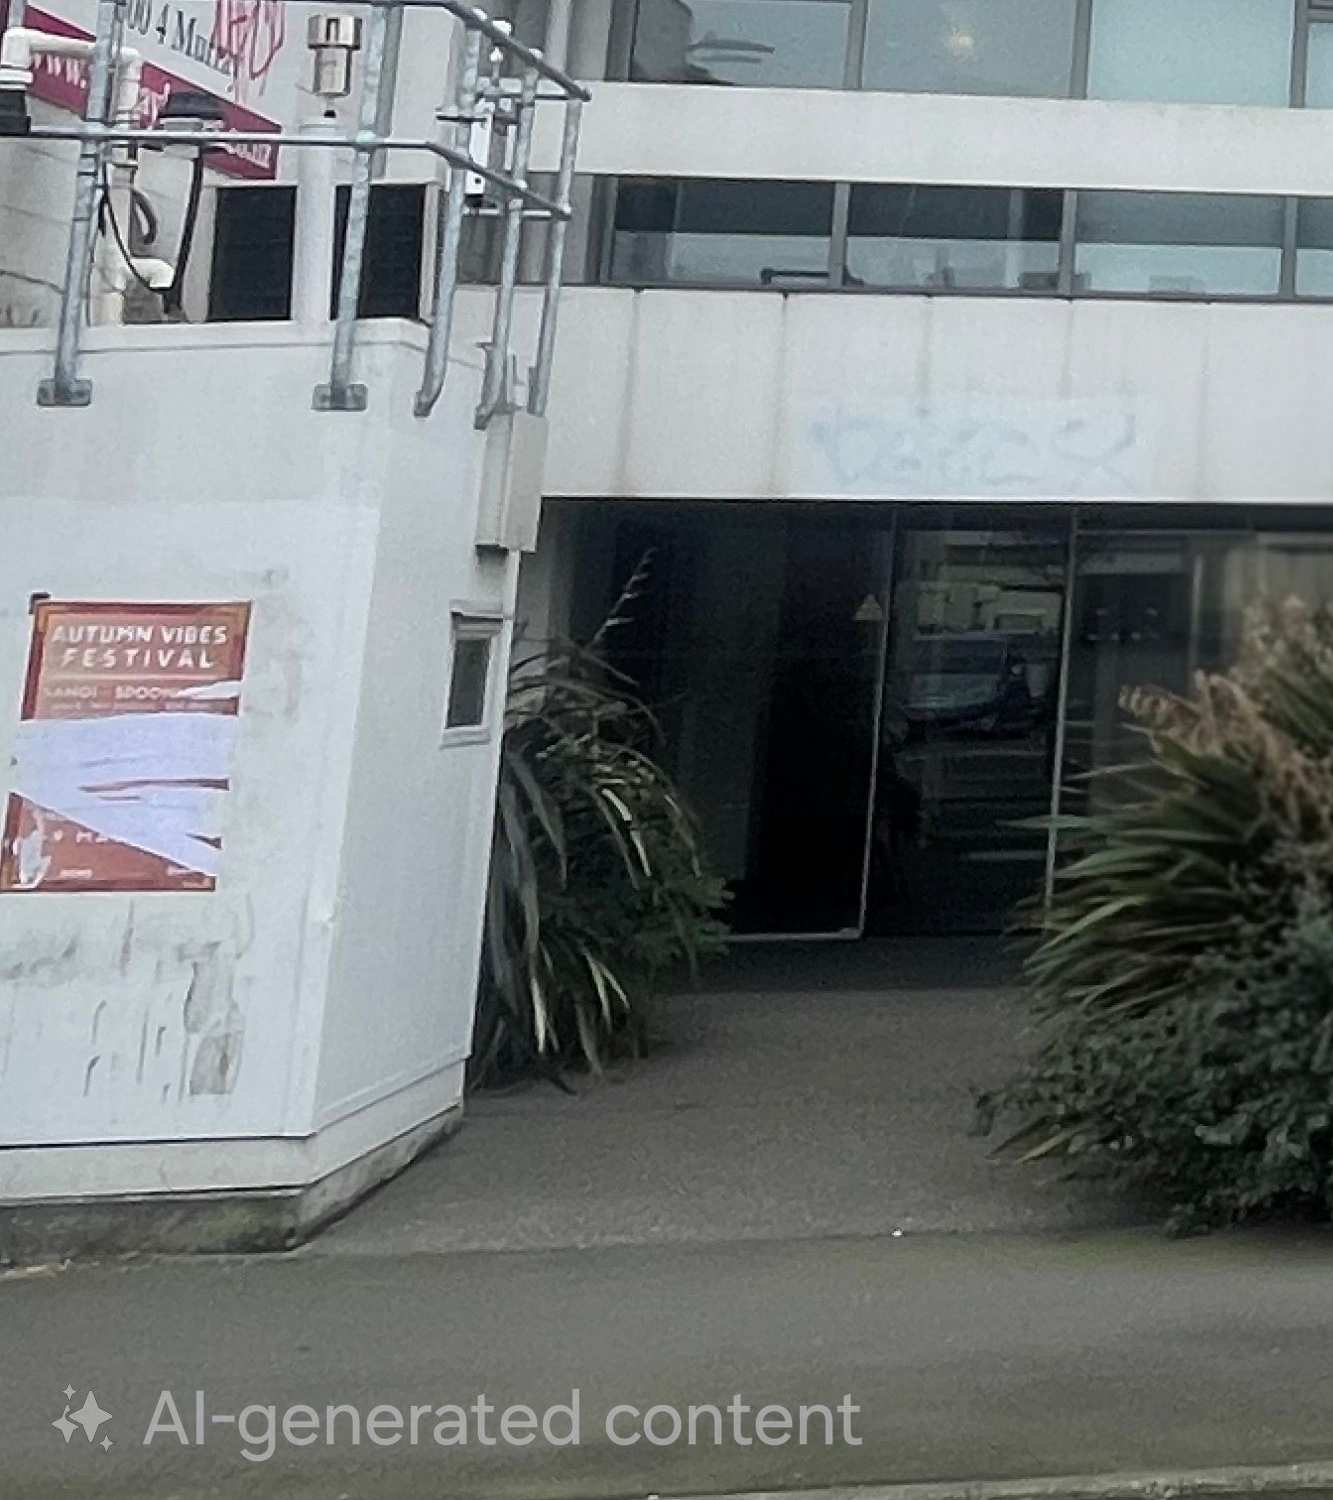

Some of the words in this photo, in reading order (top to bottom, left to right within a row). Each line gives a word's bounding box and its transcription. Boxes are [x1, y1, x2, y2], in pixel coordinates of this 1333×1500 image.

[51, 625, 154, 645] AUTUMN
[160, 624, 230, 646] VIBES
[61, 647, 215, 669] FESTIVAL
